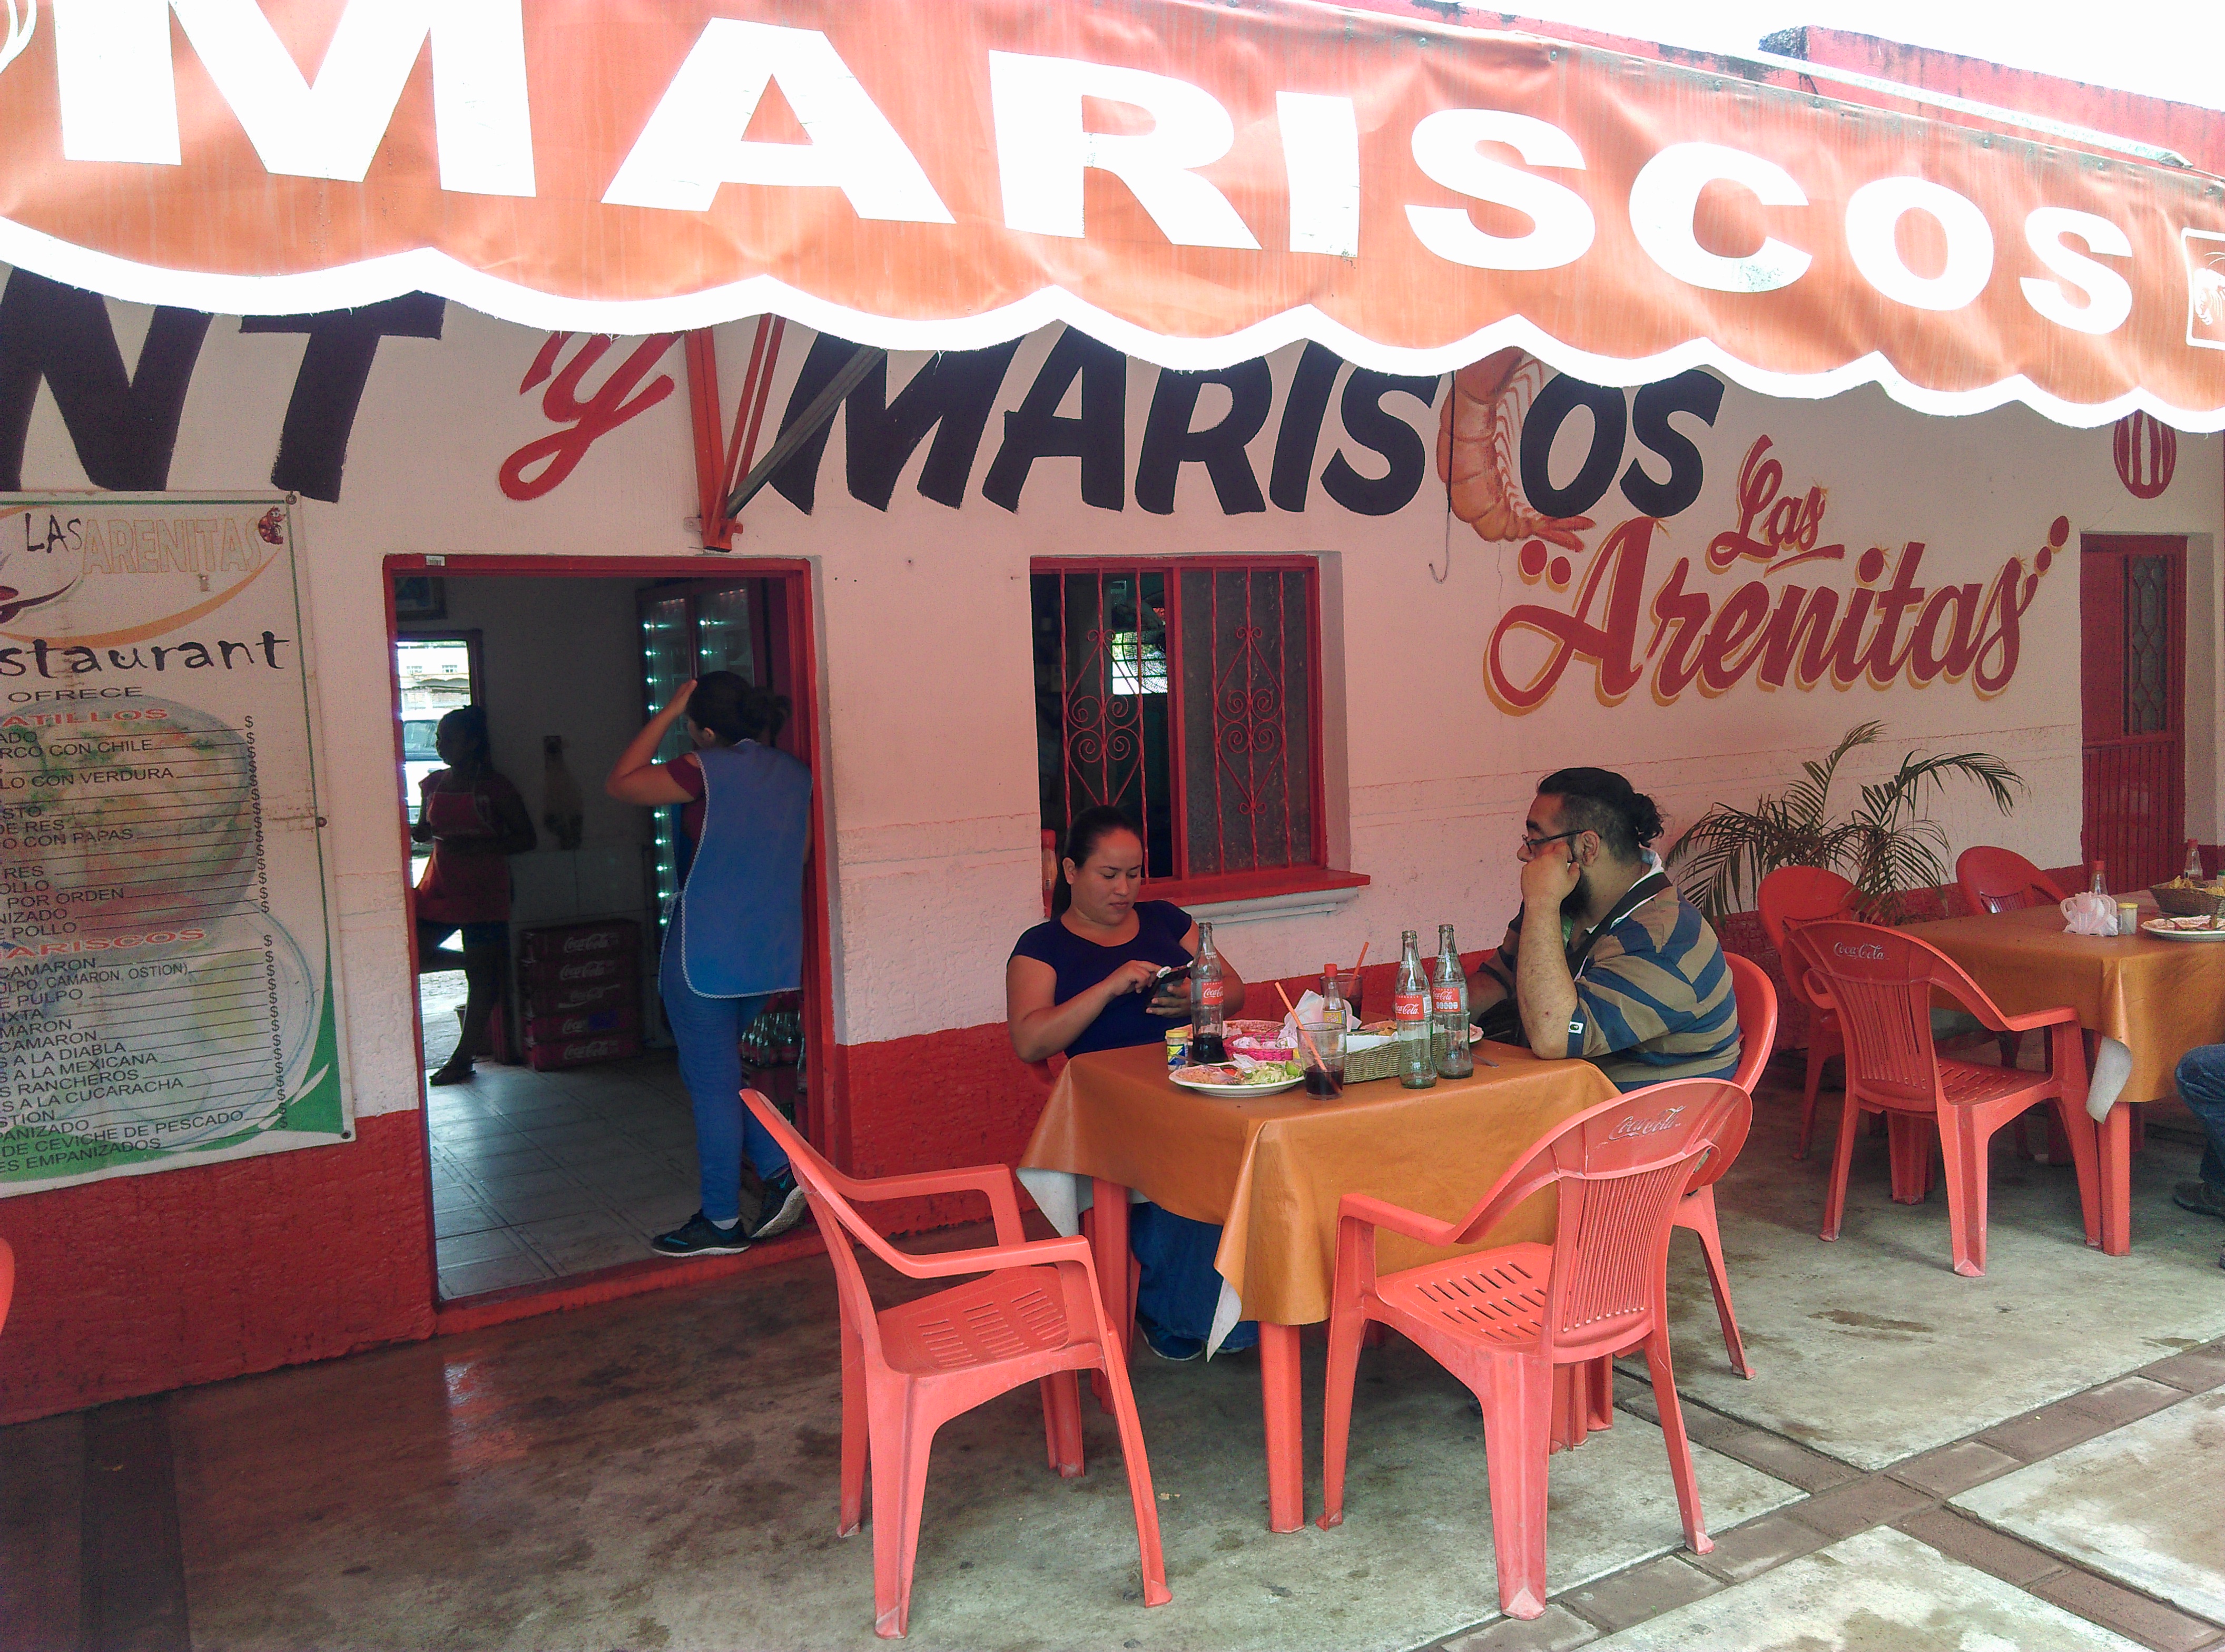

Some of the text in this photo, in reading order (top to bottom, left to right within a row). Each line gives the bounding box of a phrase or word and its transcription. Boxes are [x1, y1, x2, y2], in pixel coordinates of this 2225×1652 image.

[52, 0, 2132, 335] MARISCOS
[1705, 434, 1845, 574] Las
[25, 513, 263, 575] LAS ARENITAS
[1484, 516, 2046, 716] Arenitas
[8, 686, 143, 702] OFRECE
[50, 743, 91, 756] CON
[97, 739, 153, 753] CHILE
[32, 774, 74, 788] CON
[80, 768, 174, 784] VERDURA
[26, 819, 65, 832] RES
[24, 834, 66, 848] CON
[73, 828, 133, 843] PAPAS
[4, 866, 44, 879] RES
[7, 894, 50, 909] POR
[56, 888, 124, 904] ORDEN
[12, 922, 77, 938] POLLO
[17, 988, 83, 1007] PULPO
[31, 1051, 55, 1064] LA
[60, 1042, 126, 1060] DIABLA
[31, 1066, 55, 1079] LA
[60, 1053, 158, 1075] MEXICANA
[18, 1069, 140, 1096] RANCHEROS
[37, 1095, 61, 1107] LA
[65, 1078, 184, 1104] CUCARACHA
[0, 1119, 90, 1143] ANIZADO
[2, 1143, 28, 1158] DE
[35, 1127, 118, 1153] CEVICHE
[124, 1125, 150, 1138] DE
[155, 1110, 244, 1134] PESCADO
[26, 1138, 161, 1169] EMPANIZADOS
